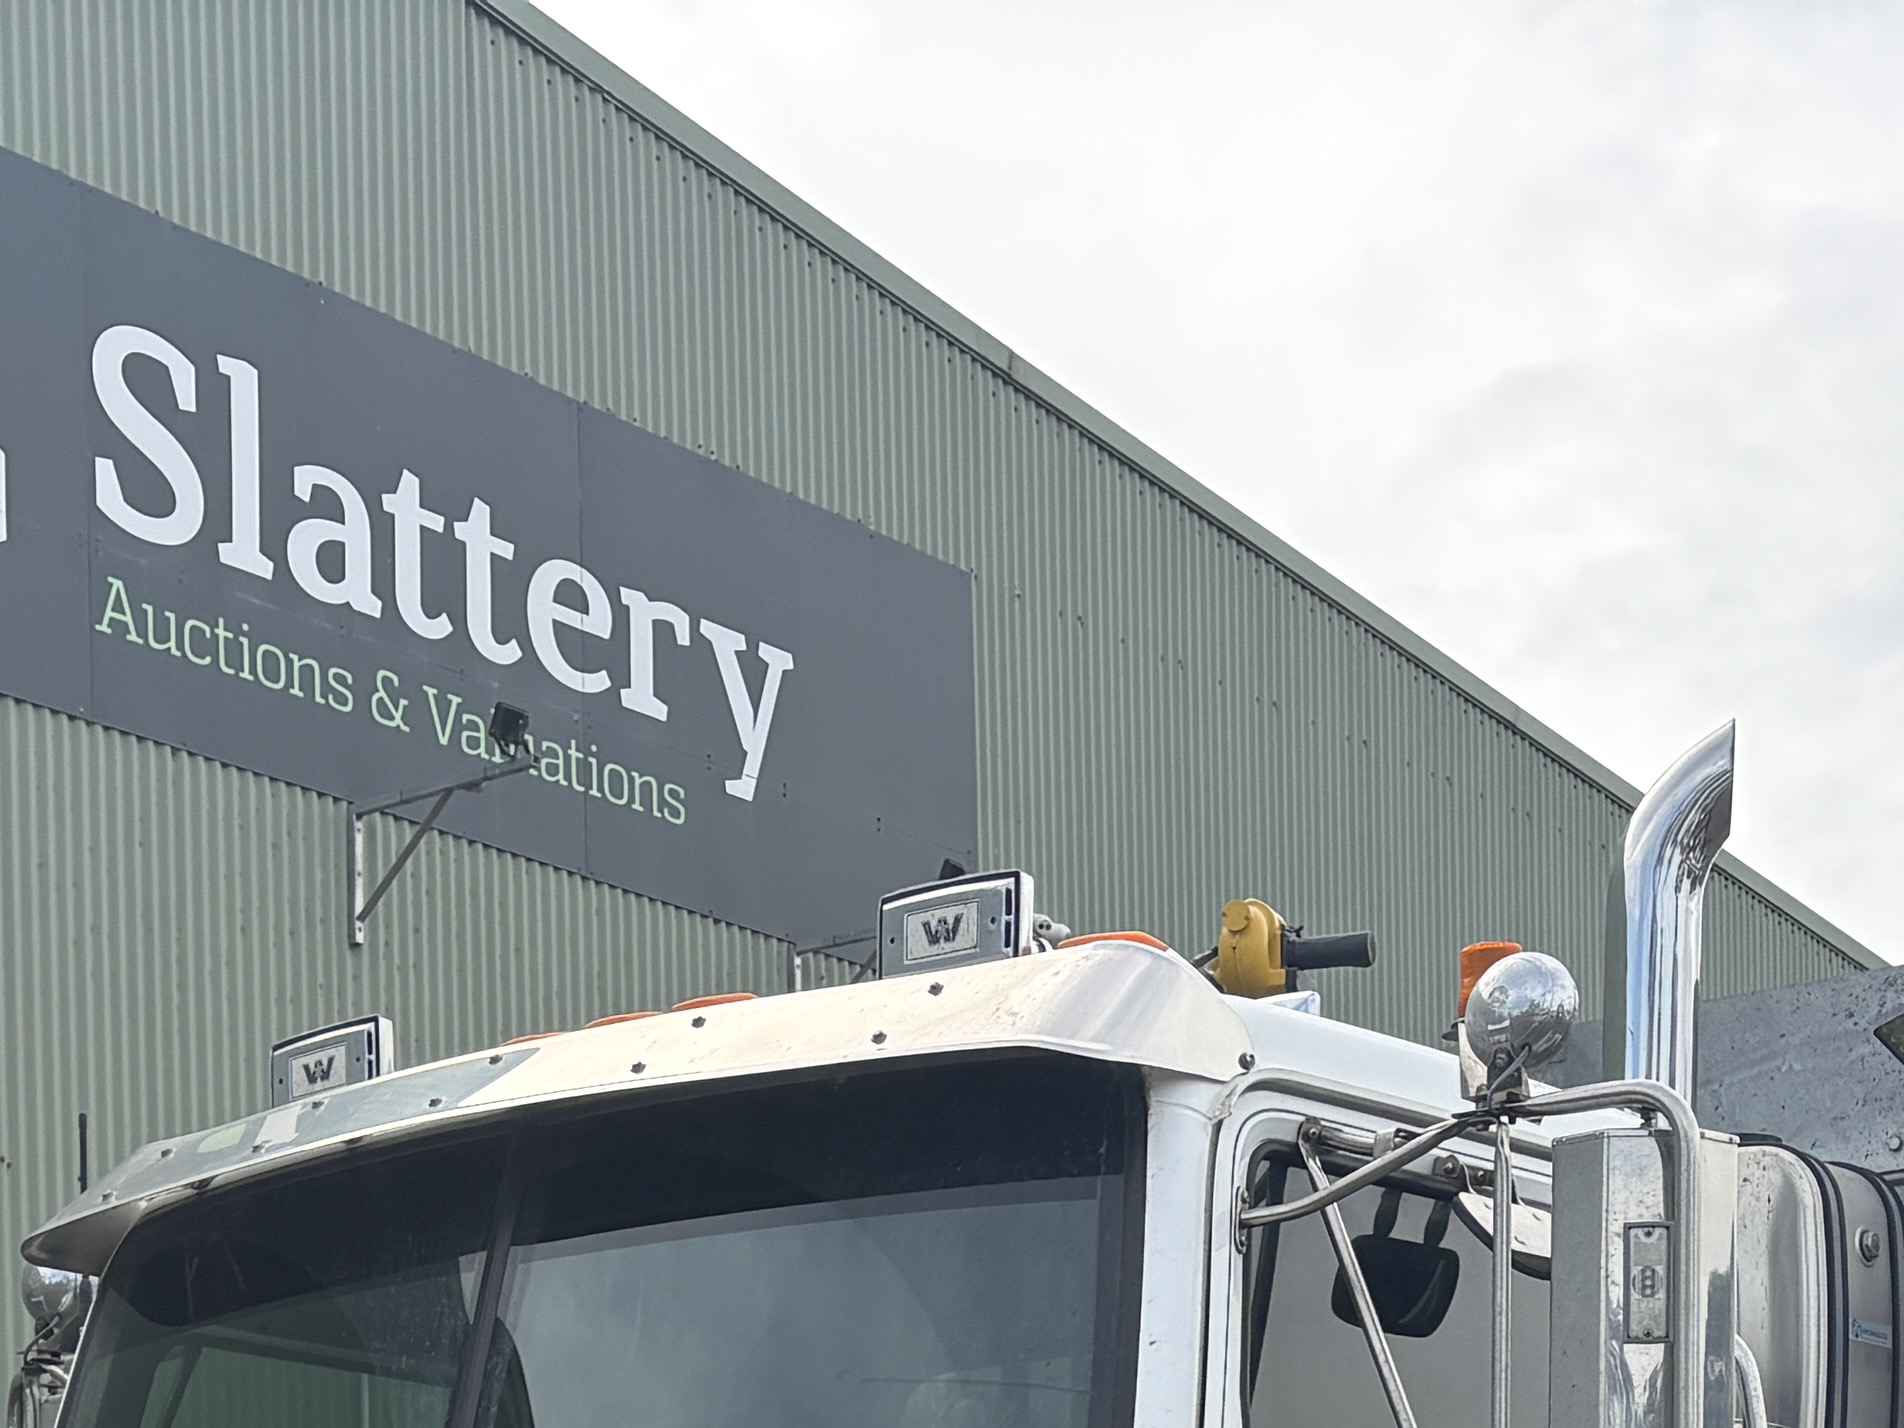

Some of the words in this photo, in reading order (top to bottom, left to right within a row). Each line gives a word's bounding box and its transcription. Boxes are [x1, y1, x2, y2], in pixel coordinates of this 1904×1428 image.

[92, 322, 794, 803] Slattery
[95, 576, 354, 713] Auctions
[371, 669, 411, 733] &
[422, 684, 687, 825] Vaations
